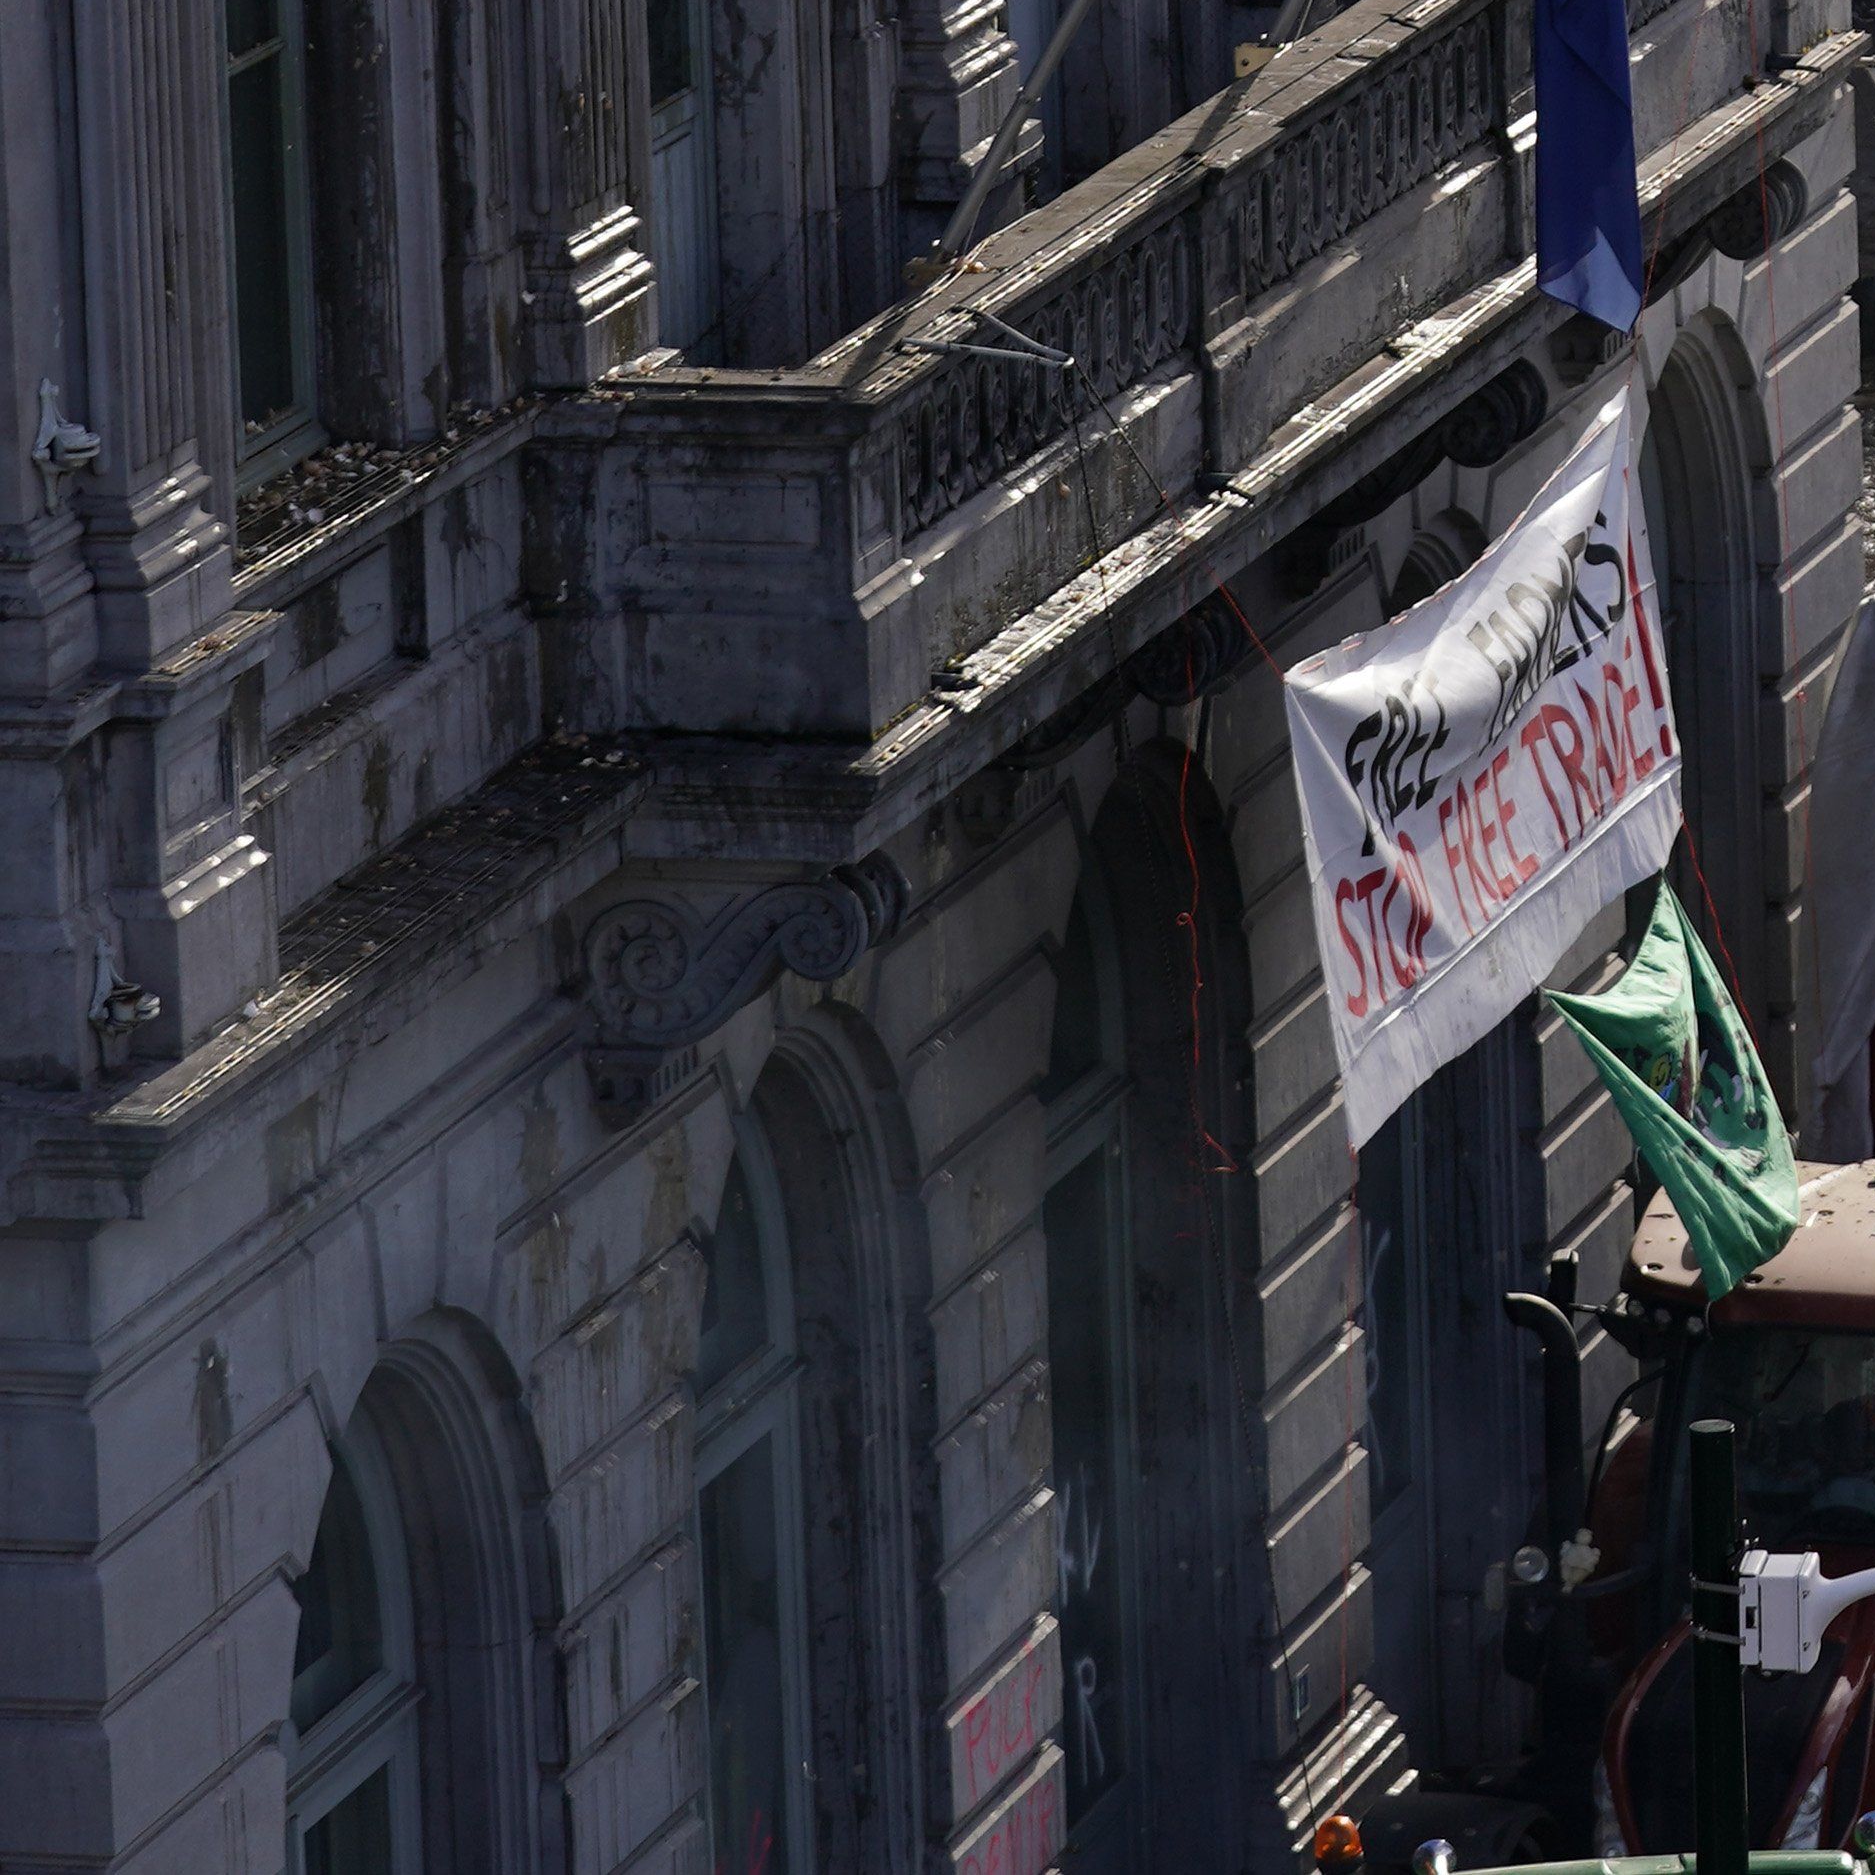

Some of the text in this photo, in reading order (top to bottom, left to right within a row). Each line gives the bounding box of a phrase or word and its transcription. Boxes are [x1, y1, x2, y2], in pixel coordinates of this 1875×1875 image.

[1345, 669, 1451, 857] FREE
[1335, 831, 1434, 1018] STOP
[1439, 746, 1541, 939] FREE
